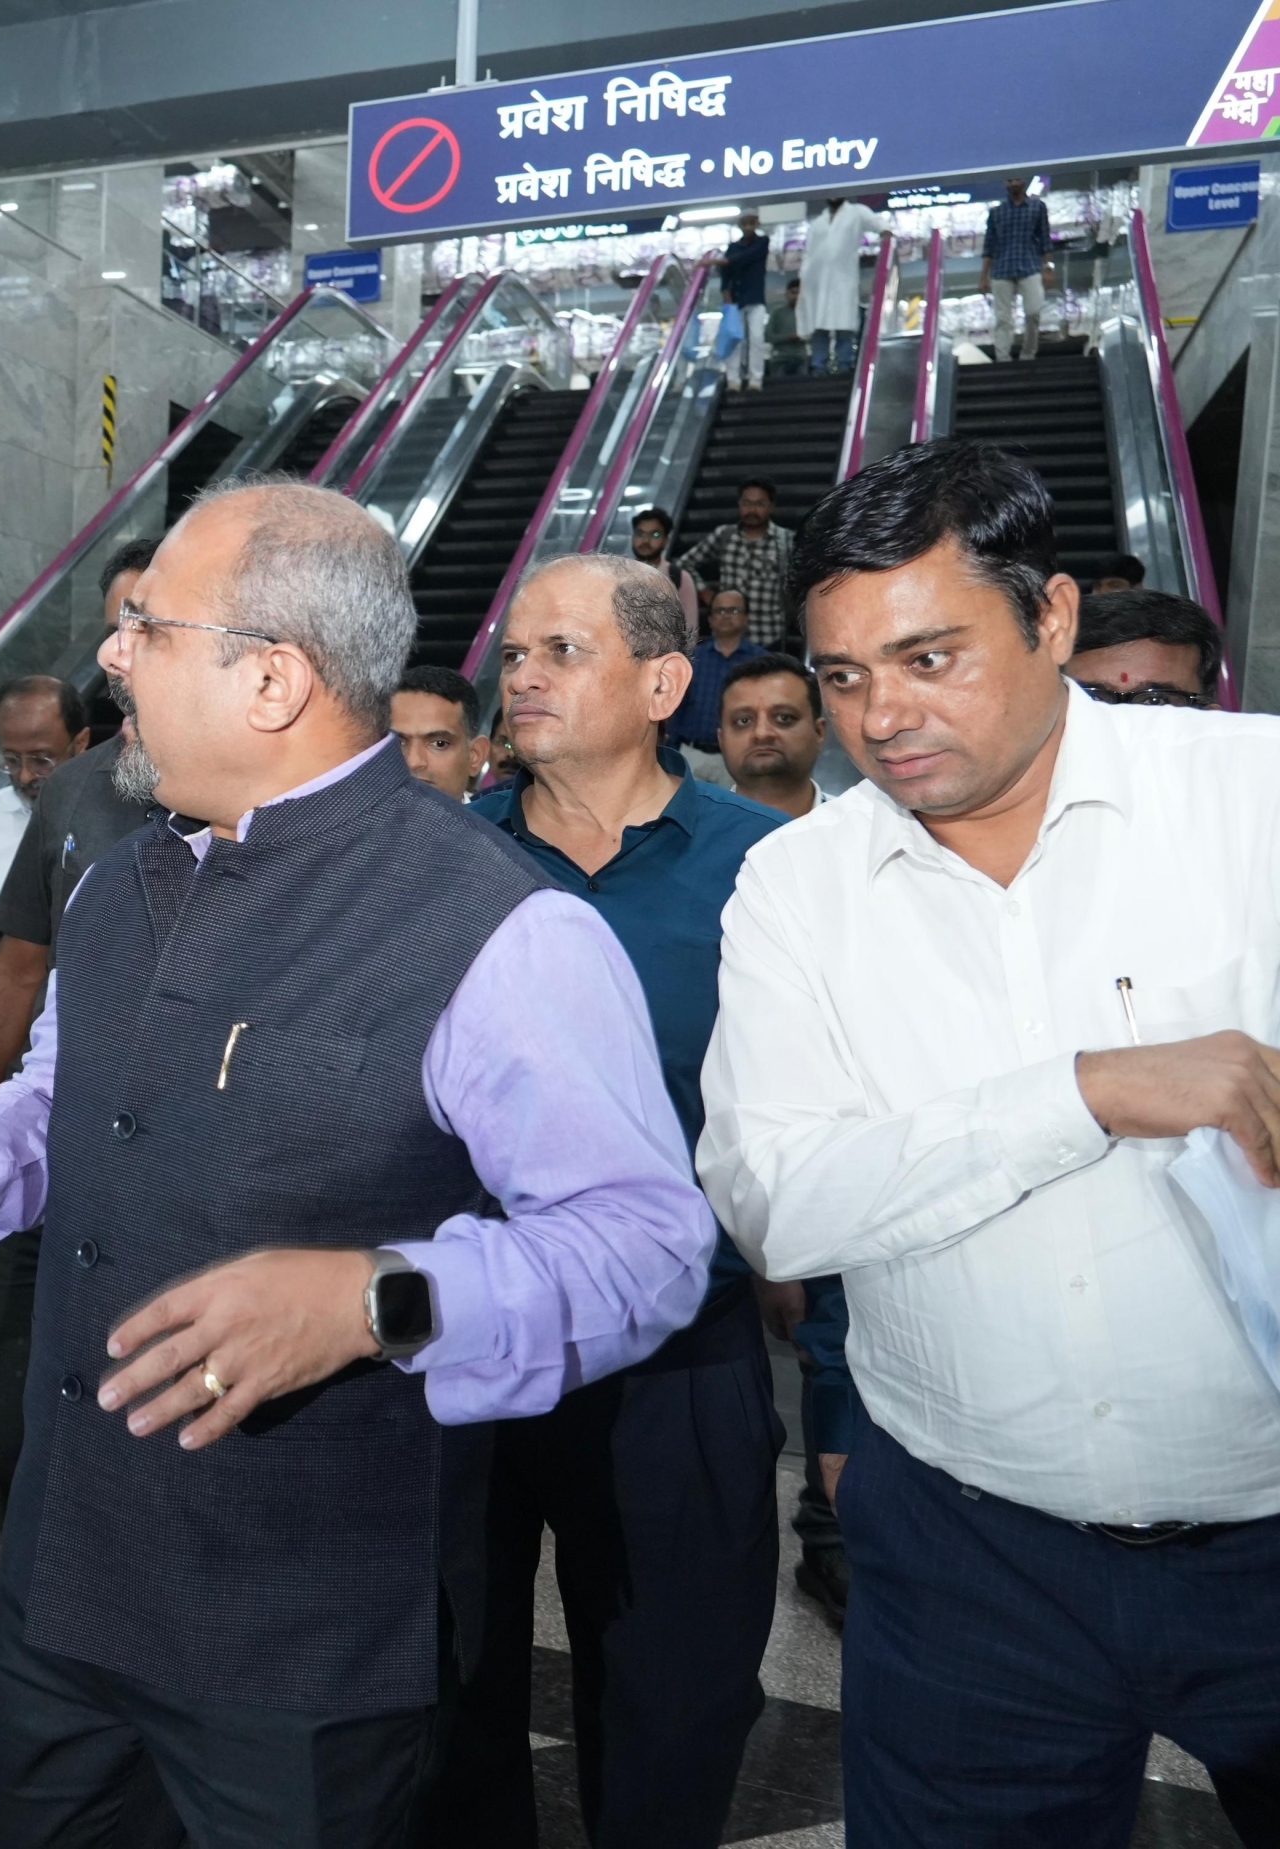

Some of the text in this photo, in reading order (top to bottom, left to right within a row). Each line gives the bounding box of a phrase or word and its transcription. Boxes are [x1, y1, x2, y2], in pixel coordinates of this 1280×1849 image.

[497, 71, 732, 139] प्रवेश निषिद्ध
[495, 148, 691, 204] प्रवेश निषिद्ध
[723, 137, 879, 177] No Entry
